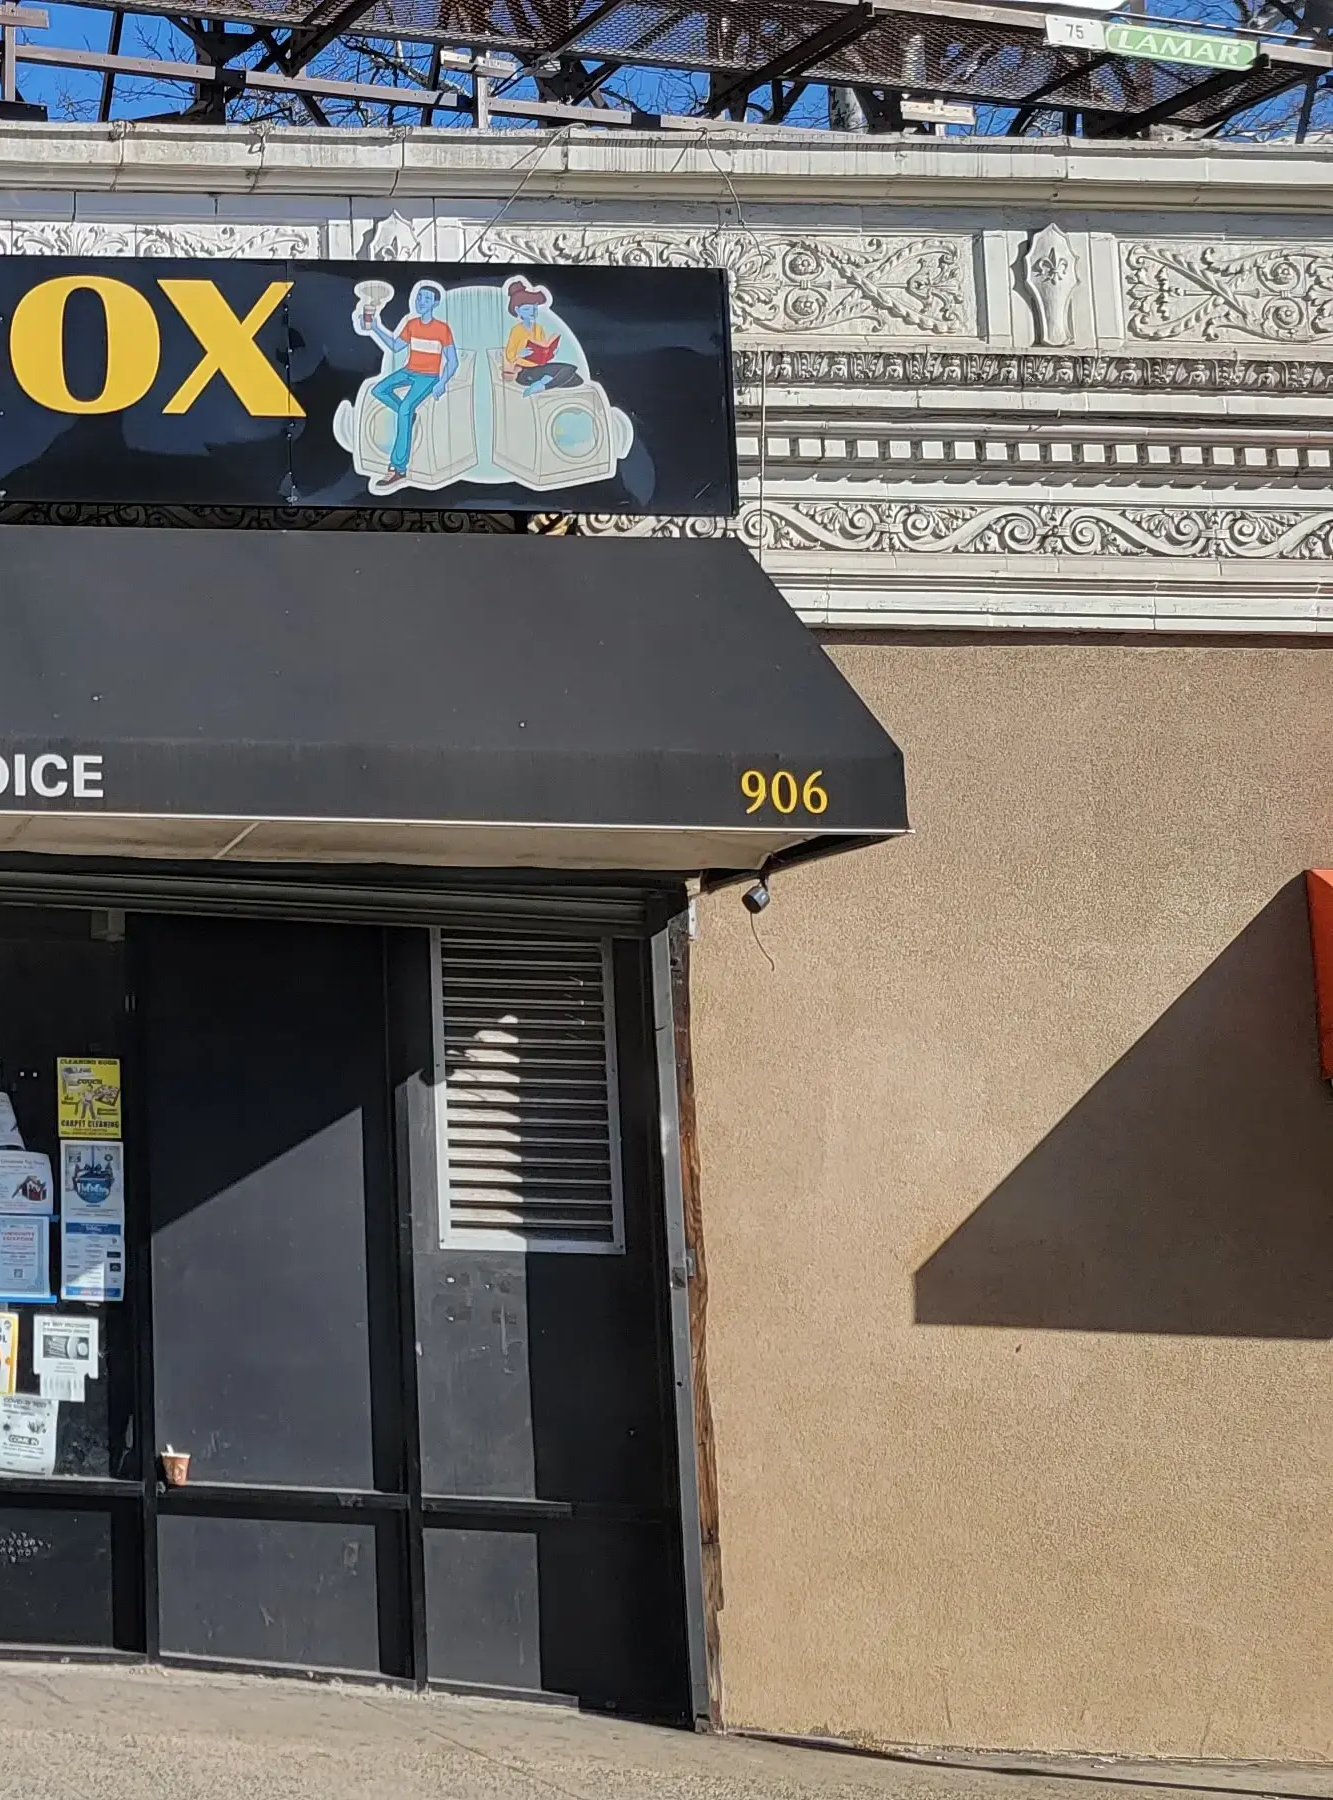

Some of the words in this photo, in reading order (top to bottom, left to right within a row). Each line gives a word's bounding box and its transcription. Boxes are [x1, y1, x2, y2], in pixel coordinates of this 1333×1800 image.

[1065, 24, 1085, 40] 75
[1118, 29, 1240, 66] LAMAR
[740, 769, 829, 815] 906
[61, 1119, 86, 1128] CARPET
[87, 1120, 120, 1129] CLEANING
